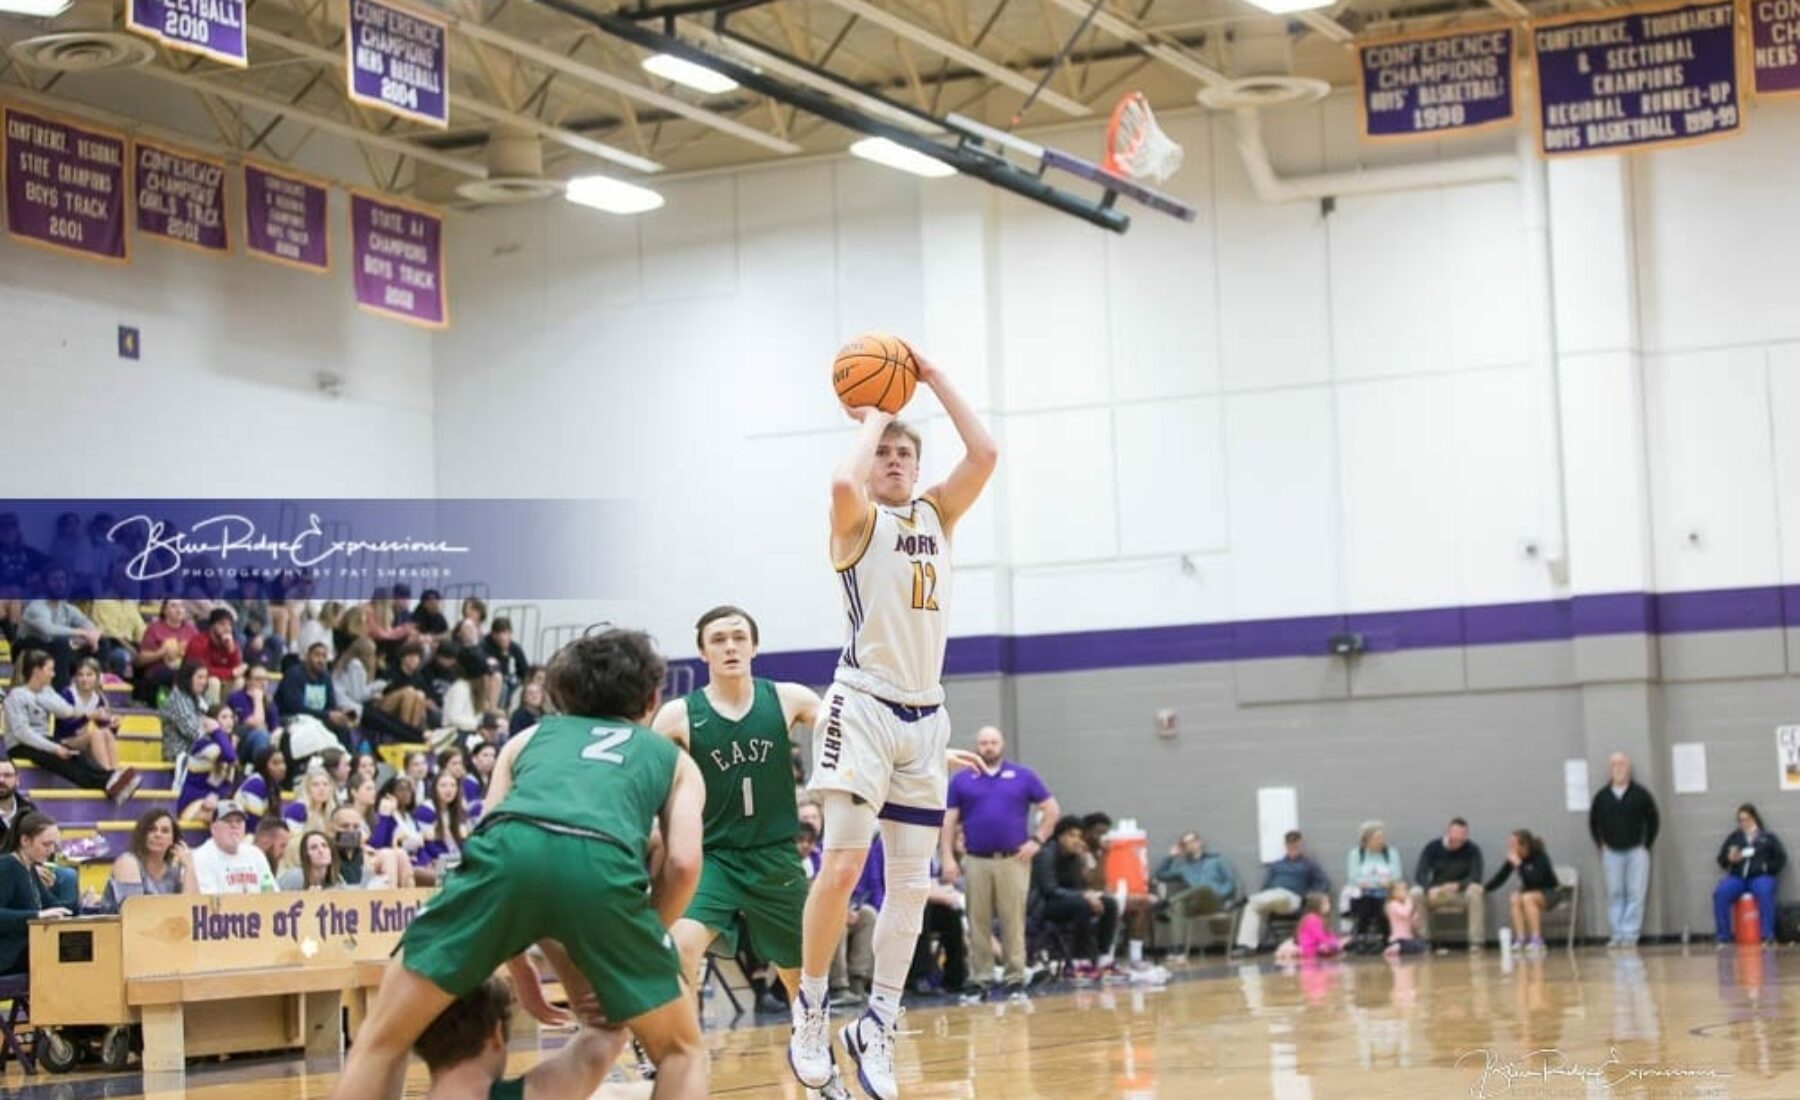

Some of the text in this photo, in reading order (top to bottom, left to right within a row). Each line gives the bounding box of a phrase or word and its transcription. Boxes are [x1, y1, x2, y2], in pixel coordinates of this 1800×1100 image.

[164, 11, 209, 43] 2010
[361, 24, 434, 69] CHAMPIONS
[1366, 32, 1508, 69] CONFERENCE
[1607, 38, 1695, 71] SECTIONAL
[1756, 44, 1798, 68] MENS
[1379, 55, 1499, 88] CHAMPIONS
[1593, 64, 1684, 95] CHAMPIONS
[1548, 95, 1626, 126] REGIONAL
[1587, 115, 1675, 146] BASKETBALL
[19, 151, 112, 193] STATE CHAMPIONS
[25, 180, 108, 220] BOYS TRACK
[49, 215, 83, 242] 2001
[368, 231, 427, 264] CHAMPIONS
[363, 253, 435, 290] BOYS TRACK
[910, 560, 939, 611] 12
[580, 726, 635, 766] 2
[710, 738, 773, 772] EAST
[742, 777, 754, 816] 1
[192, 905, 261, 941] Home
[272, 900, 305, 943] of
[316, 901, 359, 942] the
